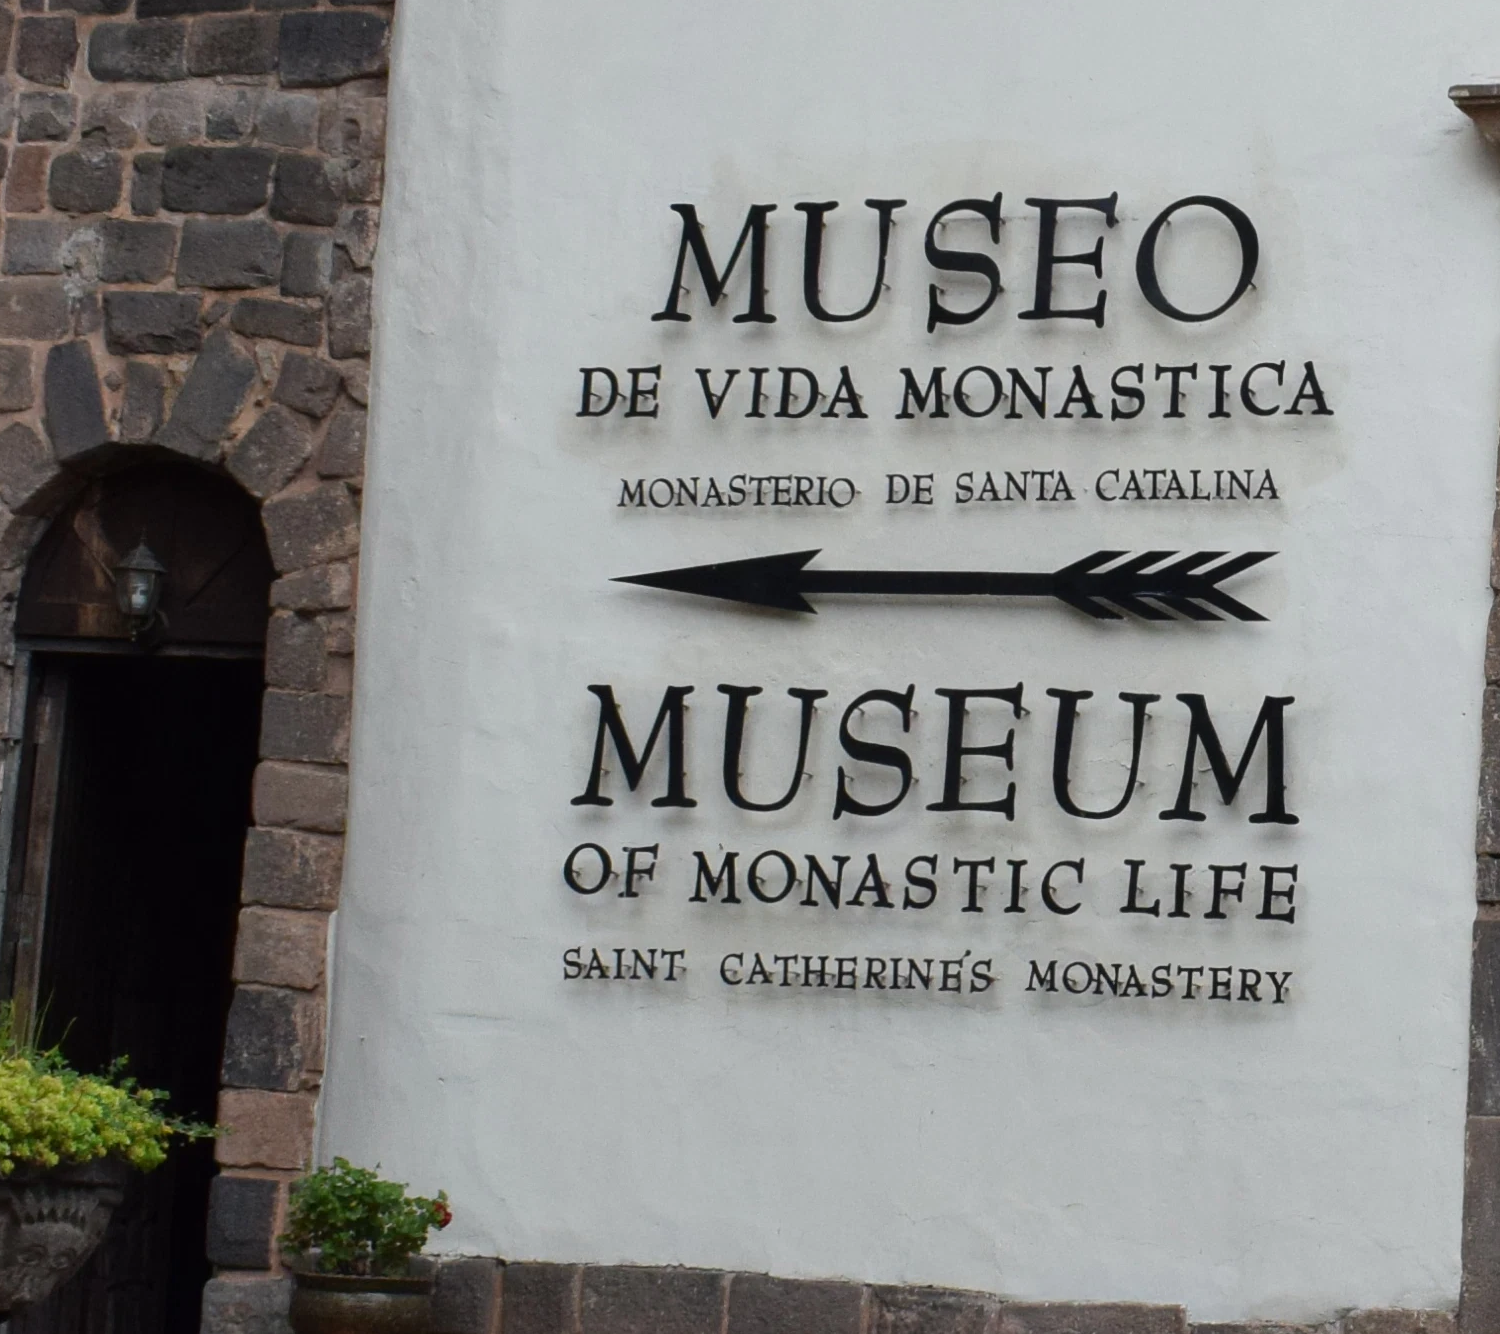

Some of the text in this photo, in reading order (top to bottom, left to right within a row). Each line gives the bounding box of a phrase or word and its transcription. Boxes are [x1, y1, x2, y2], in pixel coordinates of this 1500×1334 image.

[651, 191, 1260, 334] MUSEO
[575, 359, 1335, 422] DE VIDA MONASTICA
[616, 469, 1280, 509] MONASTERIO DE SANTA CATALINA
[570, 681, 1300, 825] MUSEUM
[562, 842, 1299, 924] OF MONASTIC LIFE
[562, 947, 686, 983] SAINT
[1025, 959, 1294, 1005] MONASTERY
